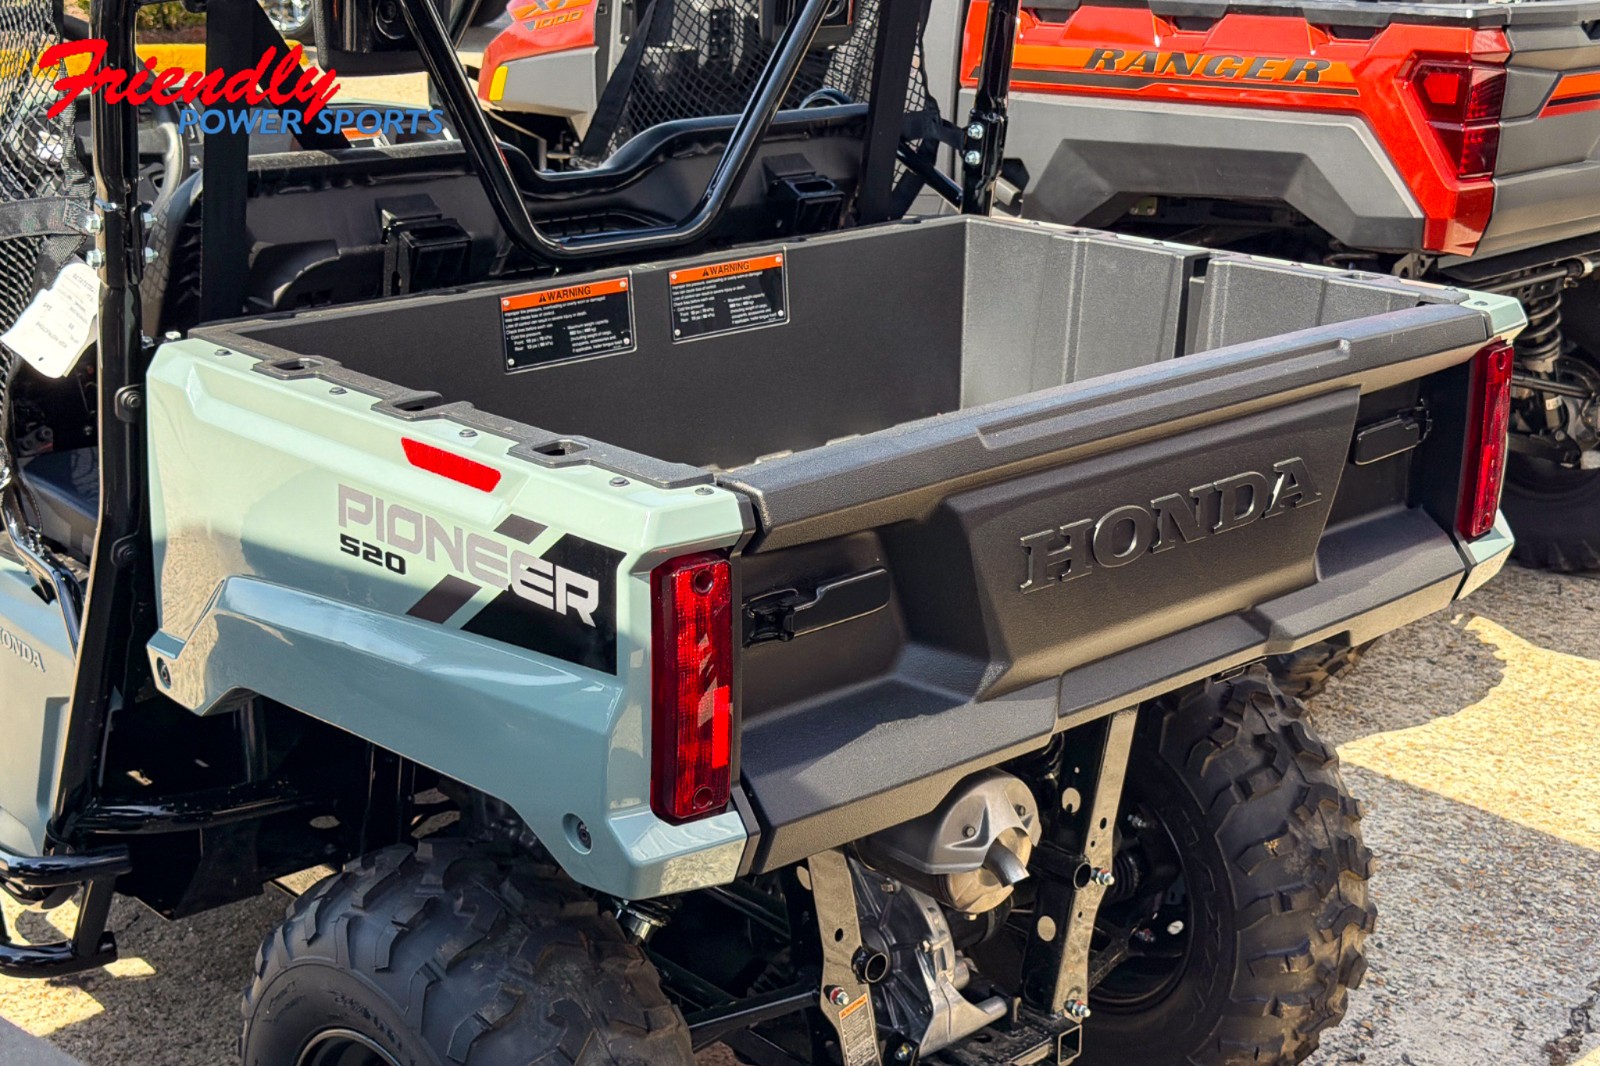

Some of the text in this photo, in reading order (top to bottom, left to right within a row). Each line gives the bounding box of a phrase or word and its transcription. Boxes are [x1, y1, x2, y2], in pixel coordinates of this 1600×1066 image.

[523, 9, 584, 32] 1000
[1082, 48, 1332, 83] RANGER
[710, 261, 750, 275] WARNING
[547, 286, 591, 300] WARNING
[1019, 456, 1323, 593] HONDA
[338, 483, 600, 629] PIONEER
[340, 533, 407, 576] 520
